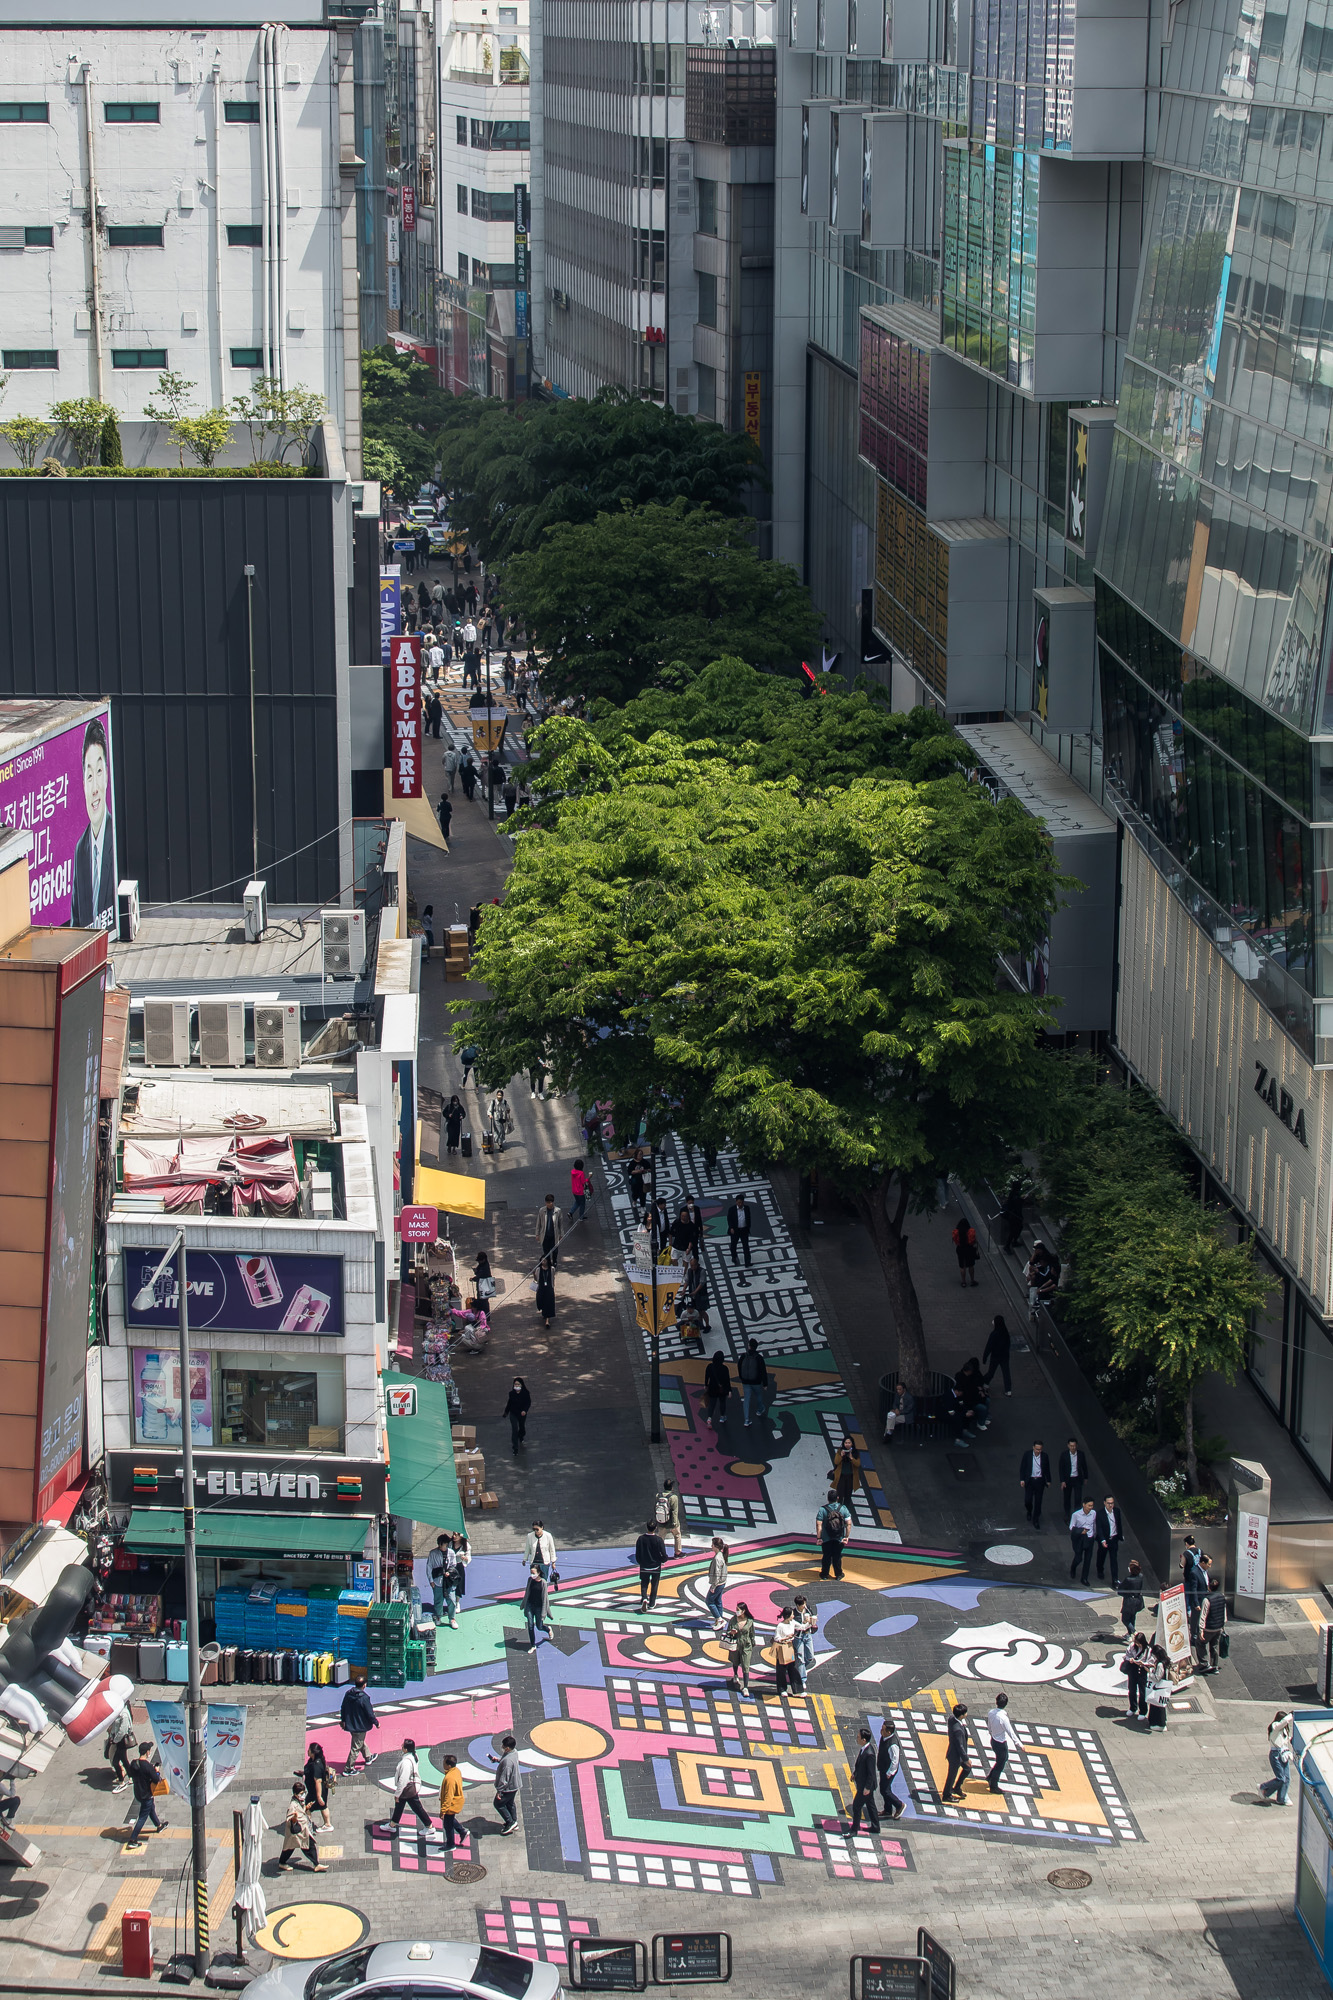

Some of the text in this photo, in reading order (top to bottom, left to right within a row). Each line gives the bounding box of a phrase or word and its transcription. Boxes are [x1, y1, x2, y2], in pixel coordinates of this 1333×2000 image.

[404, 194, 414, 223] 부동산
[746, 383, 759, 435] 부동산
[16, 755, 33, 774] Since
[32, 746, 45, 766] 1991
[18, 772, 69, 830] 처녀총각
[30, 858, 72, 916] 위하여!
[1255, 1060, 1308, 1148] ZARA
[42, 1392, 82, 1458] 광고 문의
[394, 1392, 410, 1415] 7
